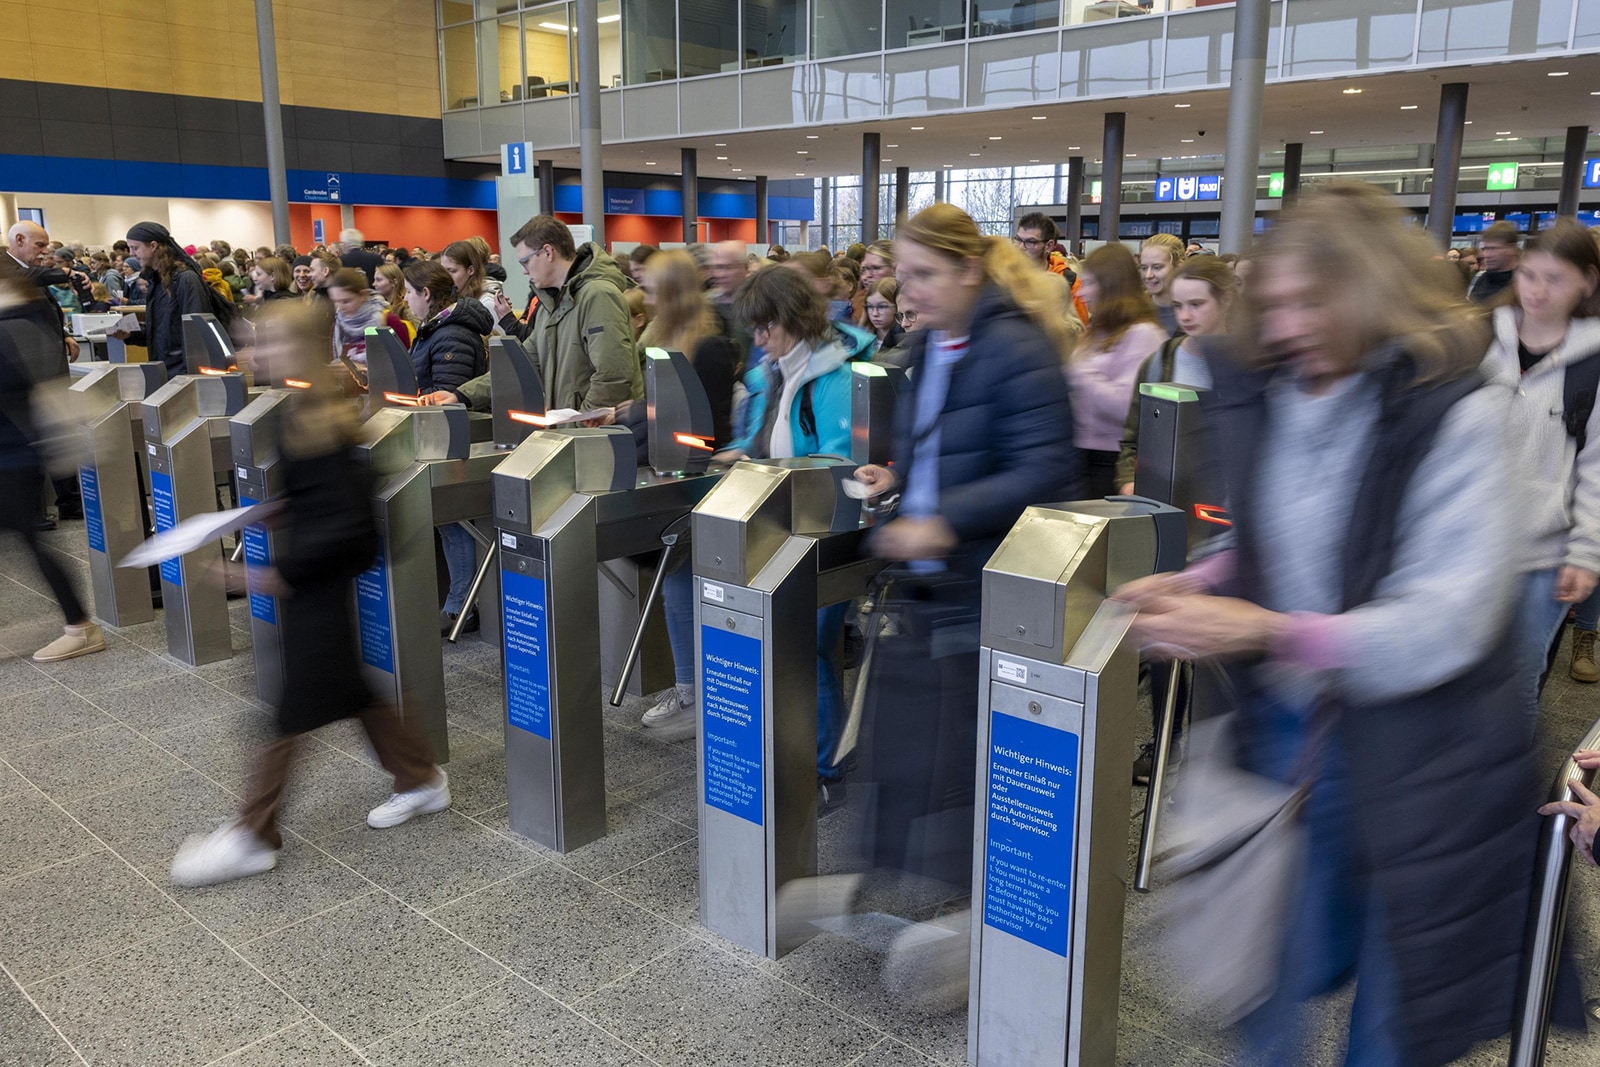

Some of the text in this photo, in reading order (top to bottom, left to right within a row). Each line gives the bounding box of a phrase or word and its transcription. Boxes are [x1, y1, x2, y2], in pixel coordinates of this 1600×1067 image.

[1160, 181, 1218, 197] P TAXI
[706, 653, 759, 675] Wichtiger Hinweis:
[706, 668, 726, 679] Erneuter
[716, 679, 749, 694] Dauerausweis
[707, 693, 749, 711] Ausstellerausweis
[707, 709, 747, 727] durch Supervisor.
[719, 705, 752, 722] Autorisierung
[708, 732, 737, 747] Important:
[721, 751, 734, 760] want
[741, 758, 760, 768] re-enter
[721, 759, 733, 767] must
[734, 763, 746, 772] have
[994, 745, 1072, 776] Wichtiger Hinweis:
[708, 761, 743, 779] long term pass.
[713, 771, 728, 782] Before
[993, 762, 1061, 790] Erneuter Einlaß nur
[708, 779, 720, 787] must
[721, 783, 732, 791] have
[992, 774, 1055, 799] mit Dauerausweis
[992, 783, 1008, 793] oder
[708, 786, 733, 799] authorized
[734, 795, 740, 803] by
[709, 794, 733, 807] supervisor.
[992, 792, 1054, 819] Ausstellerausweis
[991, 803, 1058, 832] nach Autorisierung
[991, 811, 1050, 838] durch Supervisor.
[990, 838, 1033, 861] Important:
[995, 866, 1007, 877] You
[1008, 873, 1026, 884] must
[1028, 879, 1044, 892] have
[996, 858, 1008, 868] you
[1010, 864, 1027, 875] want
[1029, 870, 1037, 878] to
[1038, 874, 1066, 889] re-enter
[989, 874, 1040, 900] long term pass.
[988, 894, 1053, 924] must have the pass
[996, 886, 1017, 900] Before
[1018, 897, 1045, 912] exiting,
[1046, 907, 1059, 917] you
[988, 904, 1047, 932] authorized by our
[988, 913, 1023, 932] supervisor.
